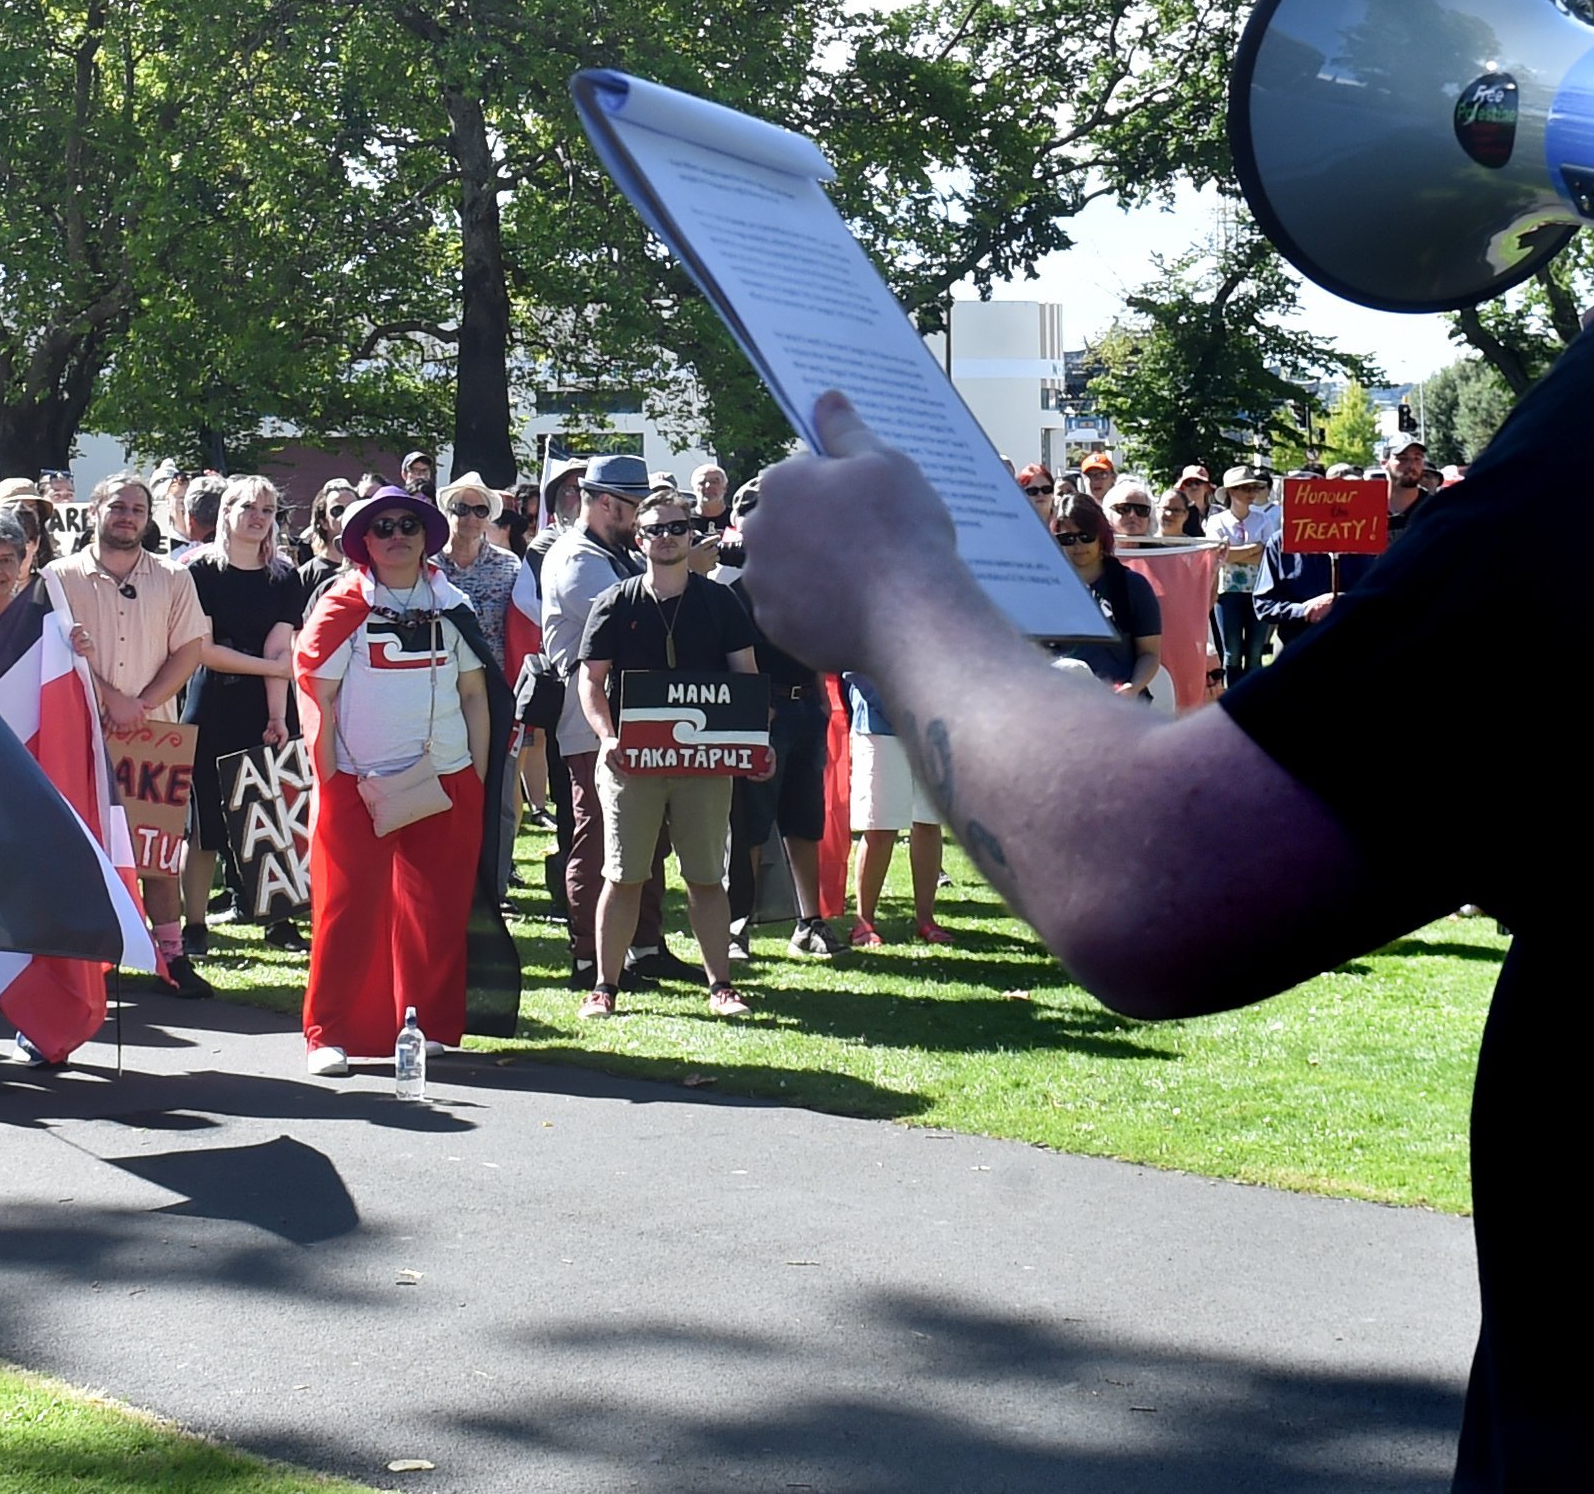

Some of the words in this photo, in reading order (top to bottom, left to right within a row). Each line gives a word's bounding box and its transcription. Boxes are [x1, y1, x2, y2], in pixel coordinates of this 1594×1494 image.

[1293, 483, 1358, 505] Honour
[667, 683, 732, 705] MANA
[625, 745, 753, 770] TAKATĀPUI
[115, 756, 194, 806] AKE
[241, 790, 311, 863] AK
[254, 847, 312, 920] AK
